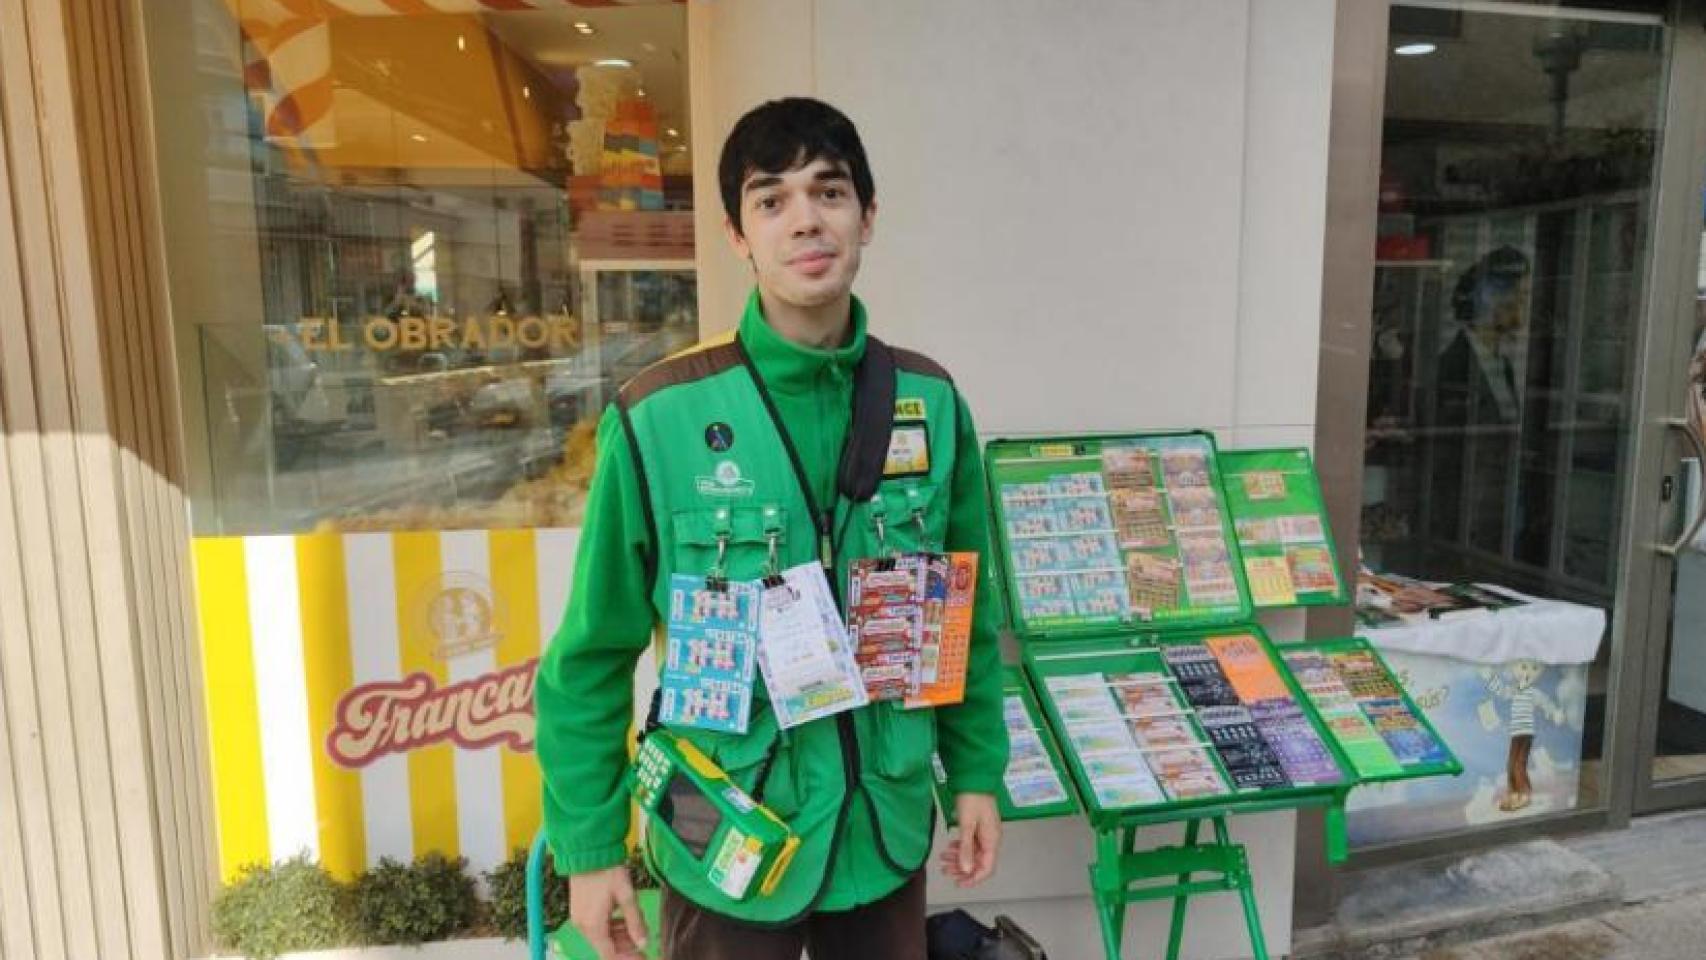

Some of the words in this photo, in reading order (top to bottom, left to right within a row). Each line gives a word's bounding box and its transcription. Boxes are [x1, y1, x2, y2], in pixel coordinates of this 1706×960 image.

[301, 316, 351, 350] EL
[363, 315, 580, 350] OBRADOR
[329, 660, 537, 767] Franca
